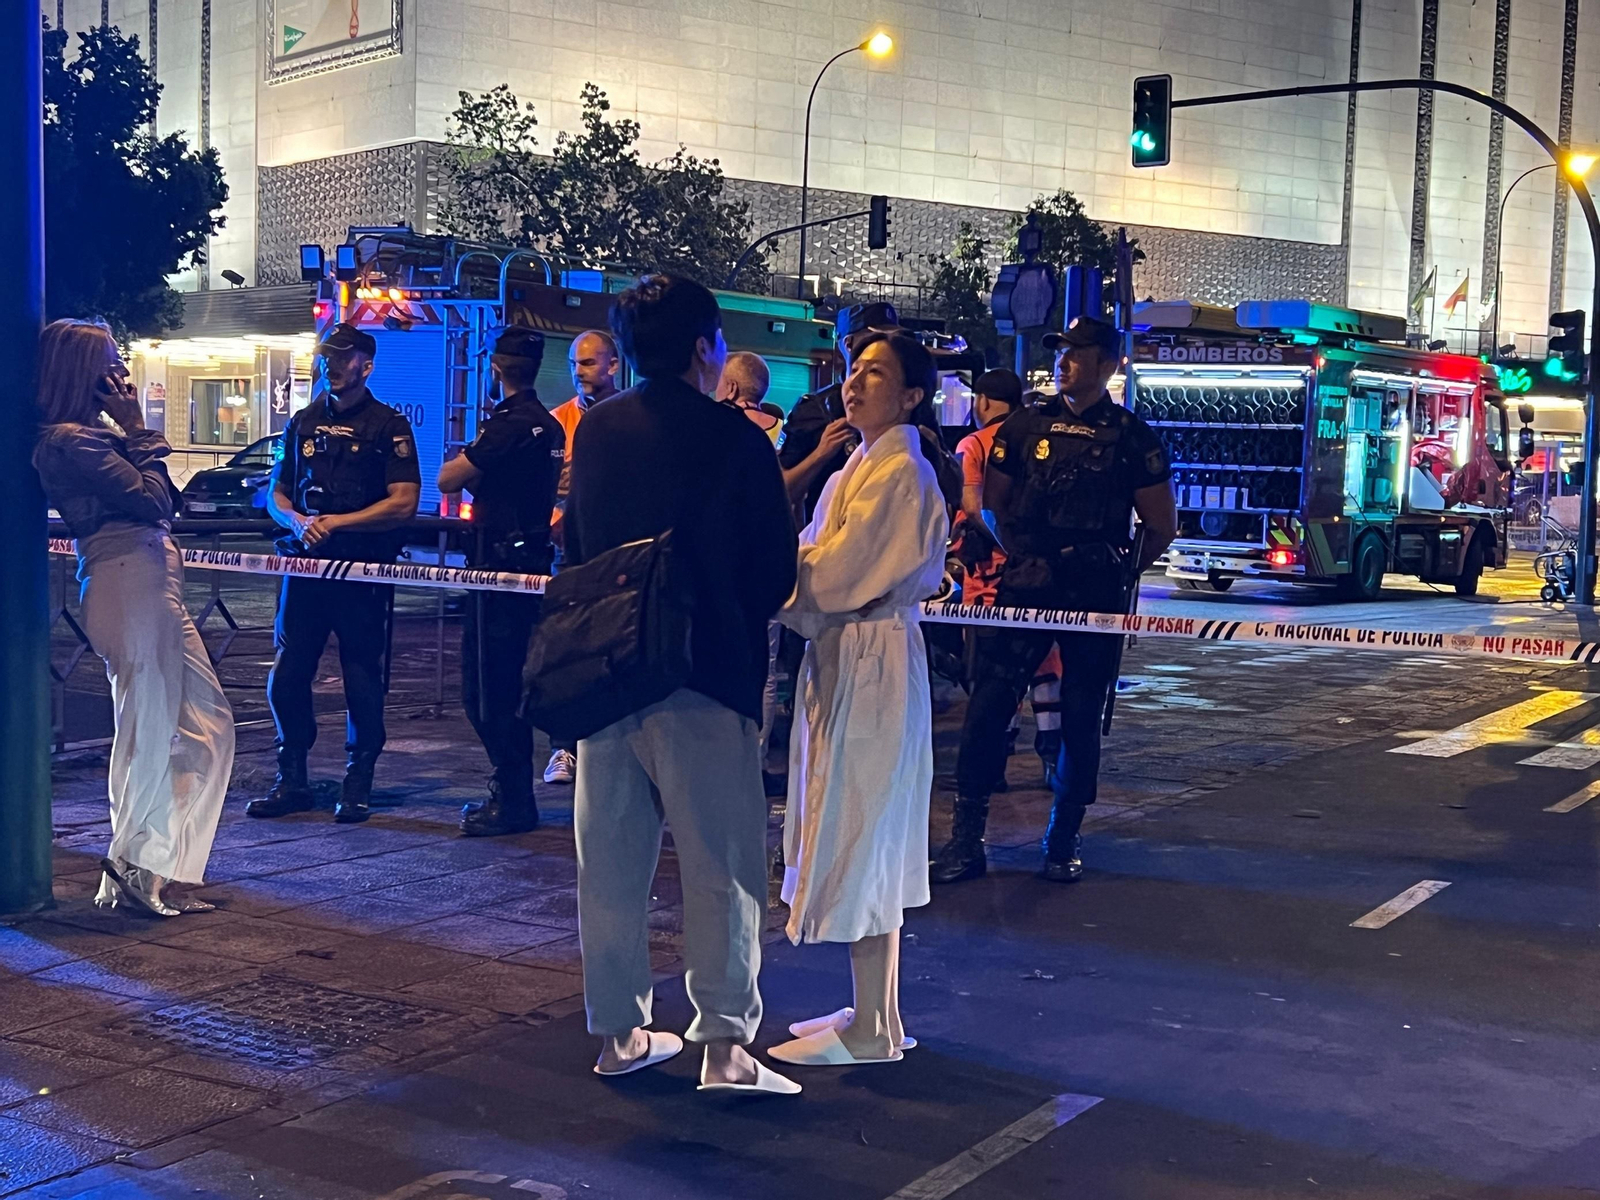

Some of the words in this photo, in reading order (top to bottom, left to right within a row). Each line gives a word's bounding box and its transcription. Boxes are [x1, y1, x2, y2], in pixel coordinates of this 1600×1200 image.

[1158, 346, 1283, 363] BOMBEROS
[184, 550, 197, 563] DE
[200, 550, 242, 567] POLICIA
[266, 556, 281, 572] NO
[284, 557, 319, 574] PASAR
[377, 564, 432, 581] NACIONAL
[436, 568, 450, 582] DE
[454, 569, 498, 586] POLICIA
[524, 575, 541, 591] NO
[941, 602, 1007, 621] NACIONAL
[1013, 607, 1029, 622] DE
[1034, 608, 1088, 627] POLICIA
[1122, 614, 1142, 631] NO
[1147, 616, 1194, 635] PASAR
[1275, 623, 1350, 642] NACIONAL
[1357, 629, 1375, 644] DE
[1381, 630, 1443, 648] POLICIA
[1483, 636, 1505, 653] NO
[1512, 638, 1565, 656] PASAR
